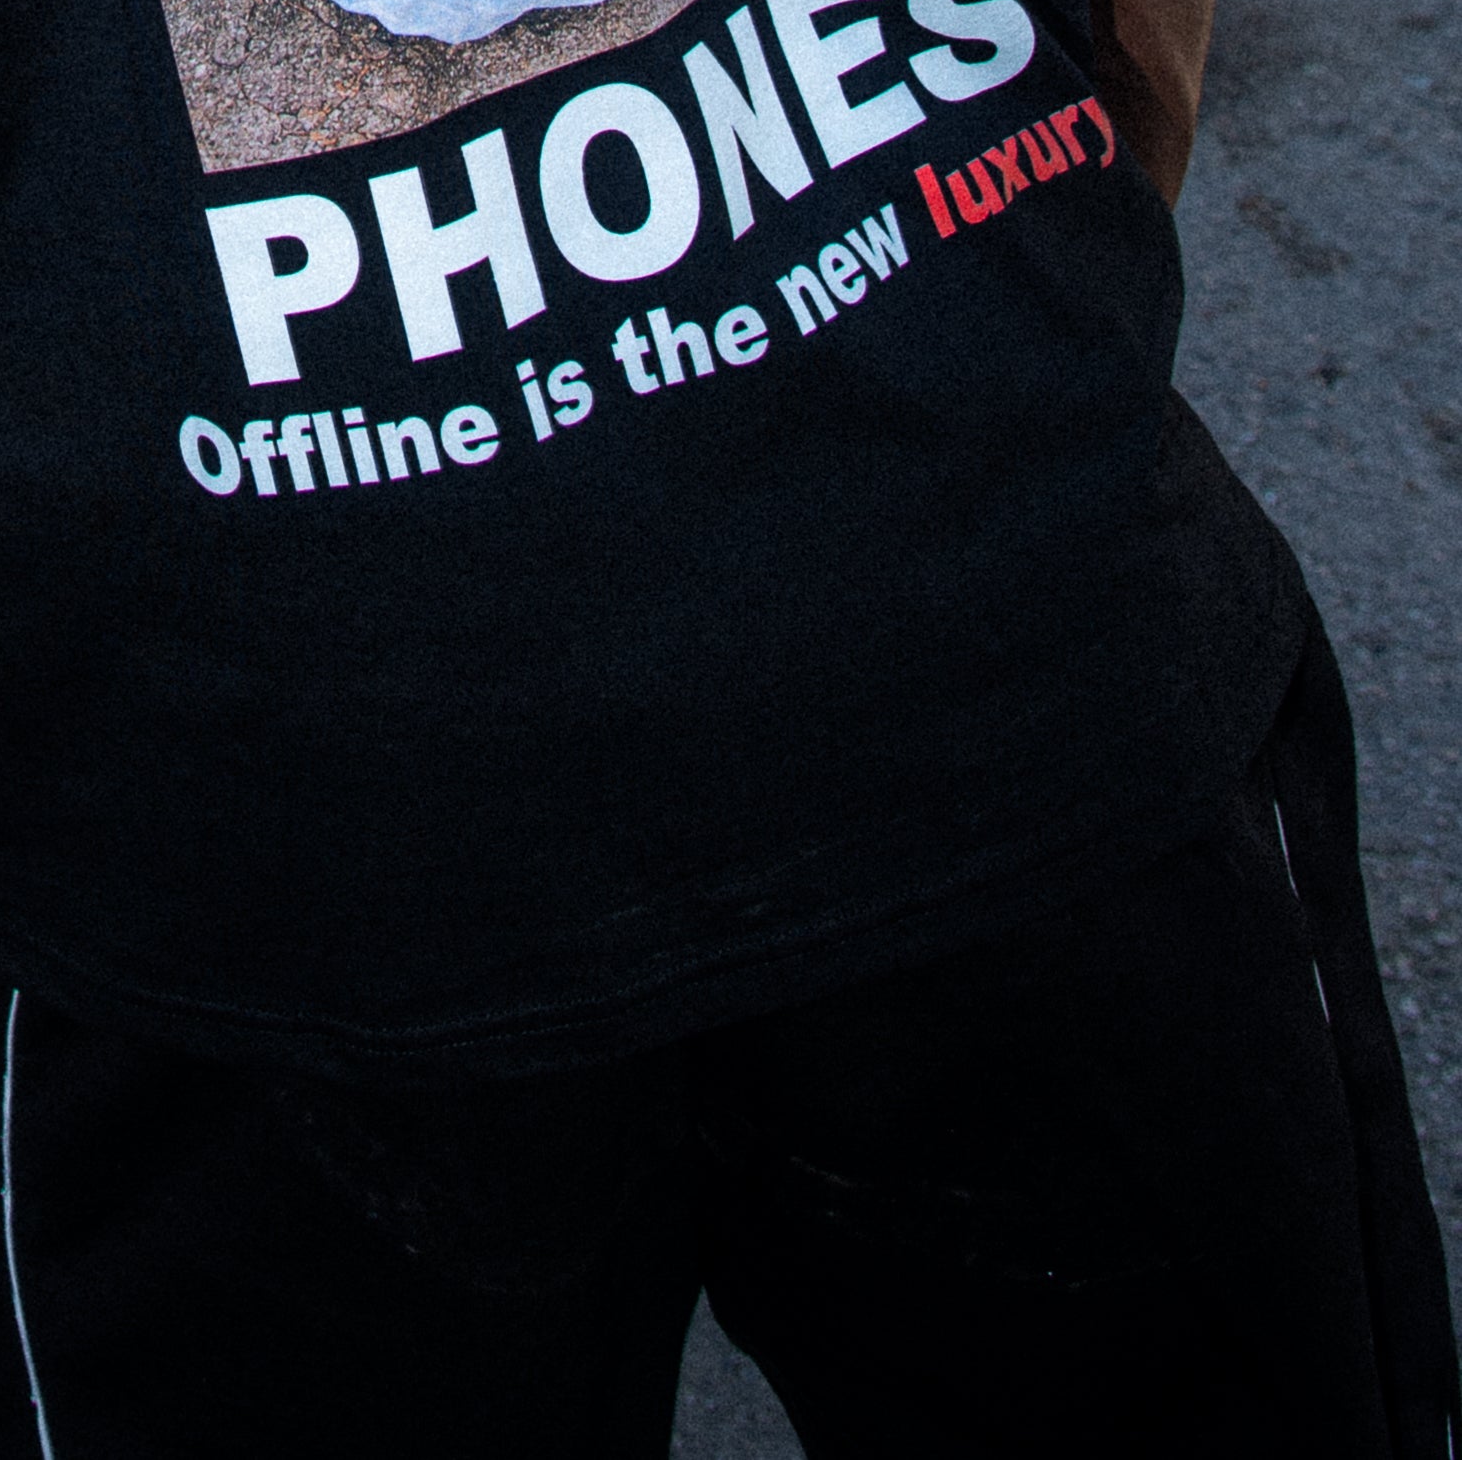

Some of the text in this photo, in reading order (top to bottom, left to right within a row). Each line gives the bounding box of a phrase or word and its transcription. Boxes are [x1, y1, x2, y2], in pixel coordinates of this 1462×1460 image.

[178, 404, 501, 496] Offline
[514, 357, 594, 442] is
[611, 305, 770, 396] the
[776, 202, 911, 335] new
